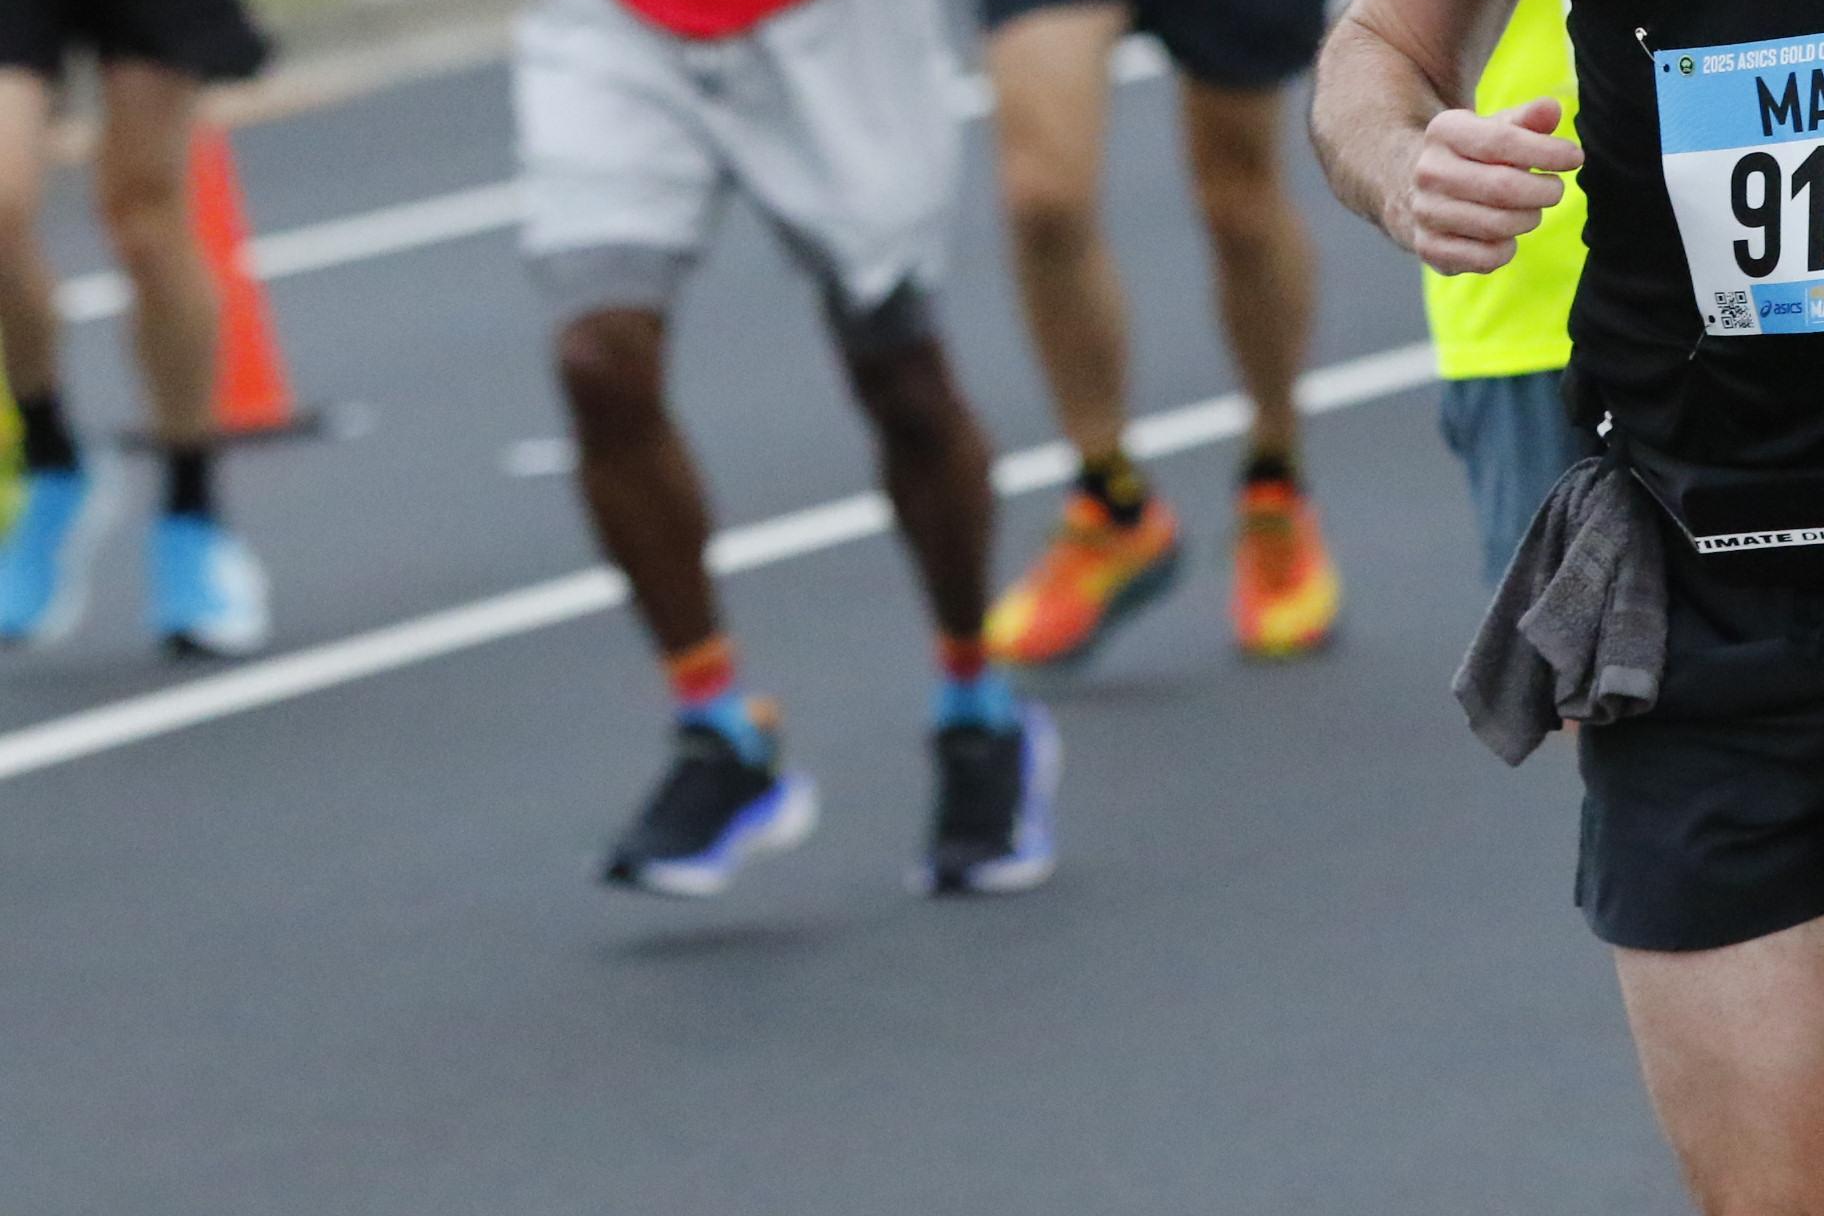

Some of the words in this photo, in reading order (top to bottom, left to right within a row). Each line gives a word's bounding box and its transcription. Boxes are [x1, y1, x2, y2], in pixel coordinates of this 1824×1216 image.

[1703, 53, 1734, 74] 2025
[1737, 49, 1777, 70] ASICS
[1780, 43, 1816, 65] GOLD
